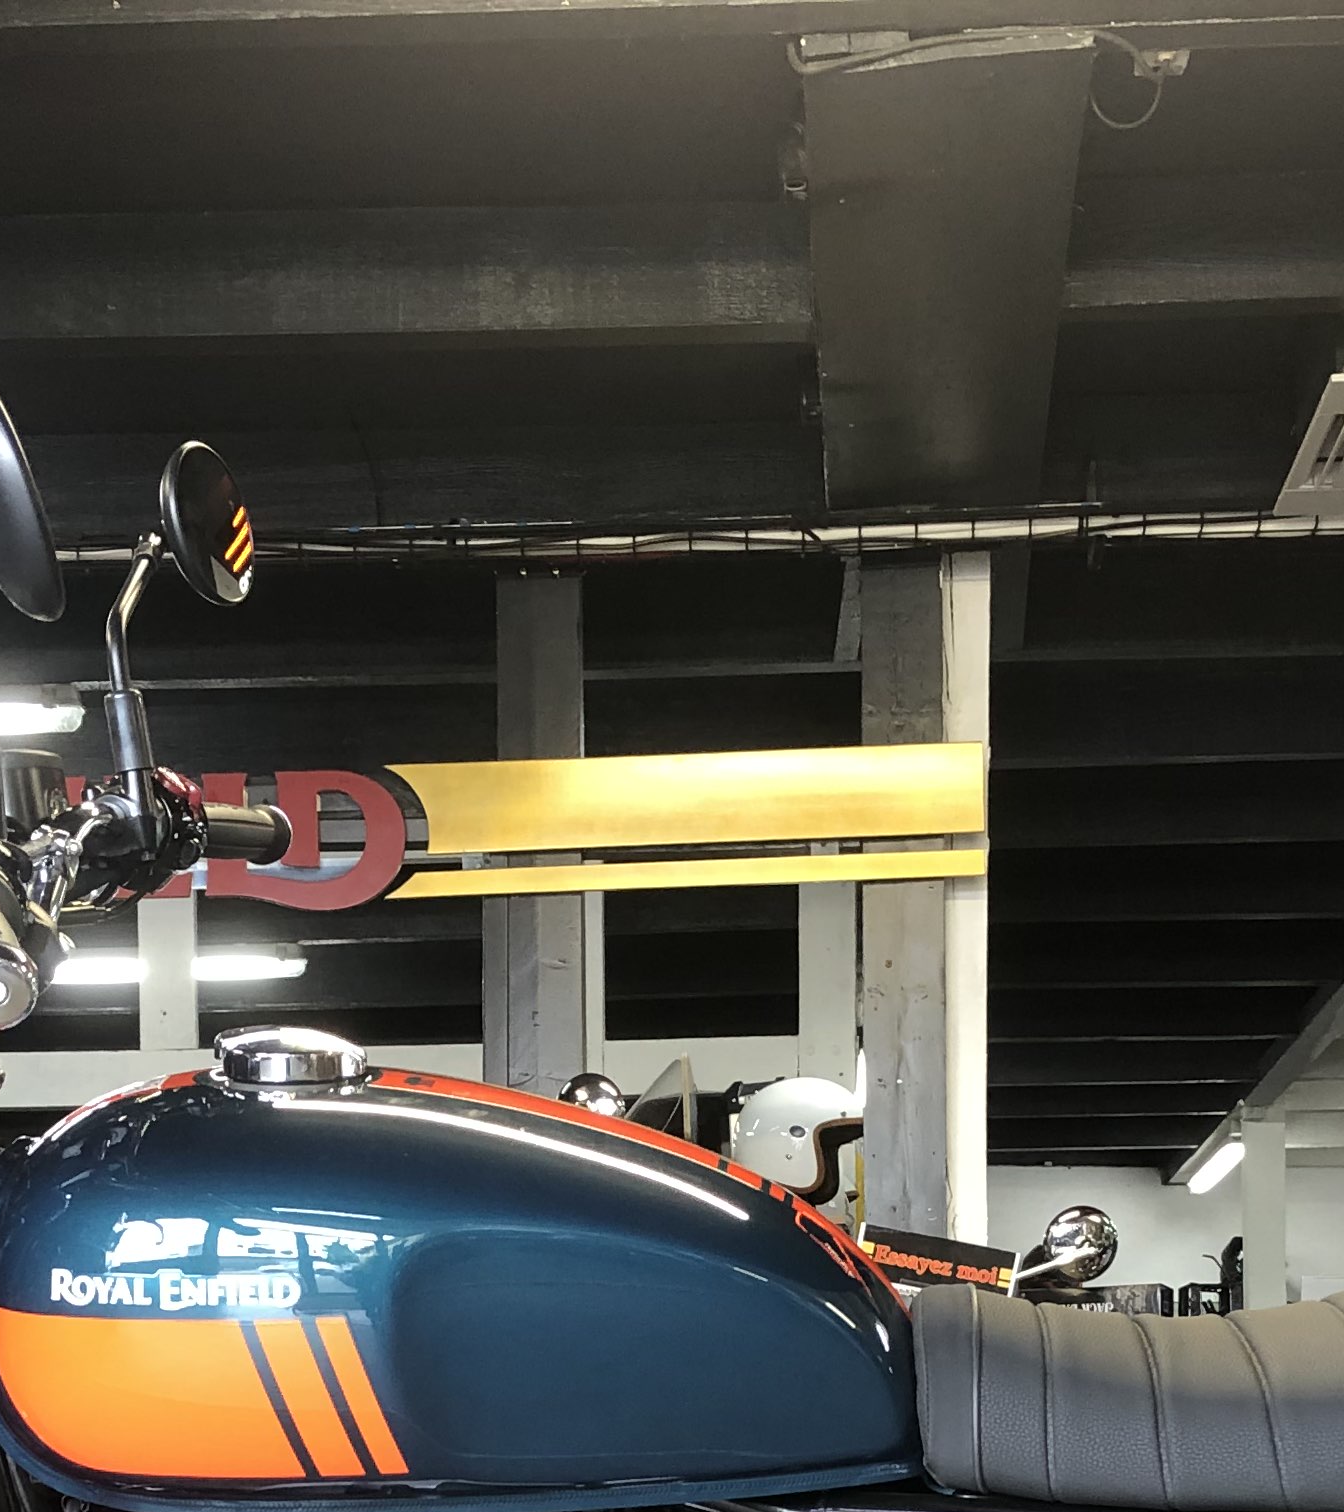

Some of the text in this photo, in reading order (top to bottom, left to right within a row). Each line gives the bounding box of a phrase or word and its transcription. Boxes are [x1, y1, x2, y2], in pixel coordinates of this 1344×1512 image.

[873, 1244, 953, 1276] Essayez
[957, 1261, 999, 1285] moi
[50, 1268, 301, 1311] ROYAL ENFIELD
